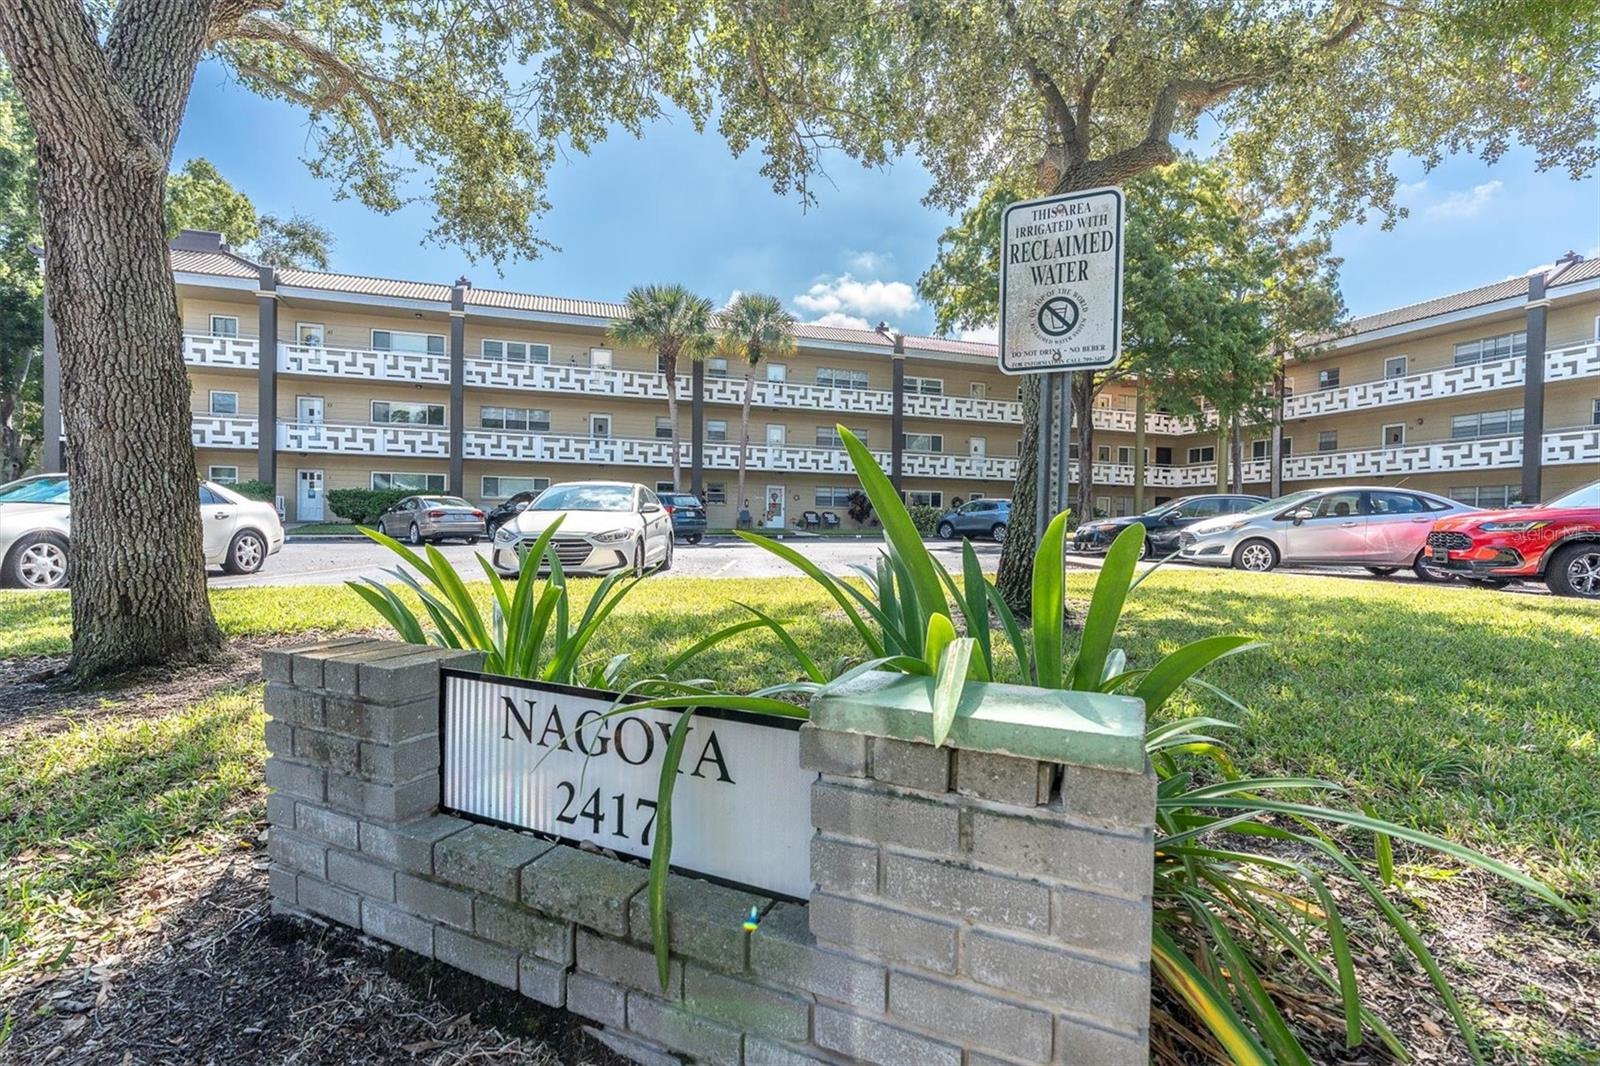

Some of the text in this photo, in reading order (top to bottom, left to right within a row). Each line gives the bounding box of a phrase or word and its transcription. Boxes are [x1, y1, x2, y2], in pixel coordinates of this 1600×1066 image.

[1032, 202, 1092, 222] THIS AREA
[1015, 214, 1108, 239] IRRIGATED WITH
[1010, 230, 1114, 265] RECLAIMED
[1031, 260, 1090, 286] WATER
[1034, 295, 1046, 307] TOP
[1046, 288, 1055, 298] OF
[1072, 291, 1089, 313] WORLD
[1011, 351, 1022, 359] DO
[1023, 350, 1037, 358] NOT
[1082, 344, 1106, 353] BEBER
[556, 780, 660, 848] 2417
